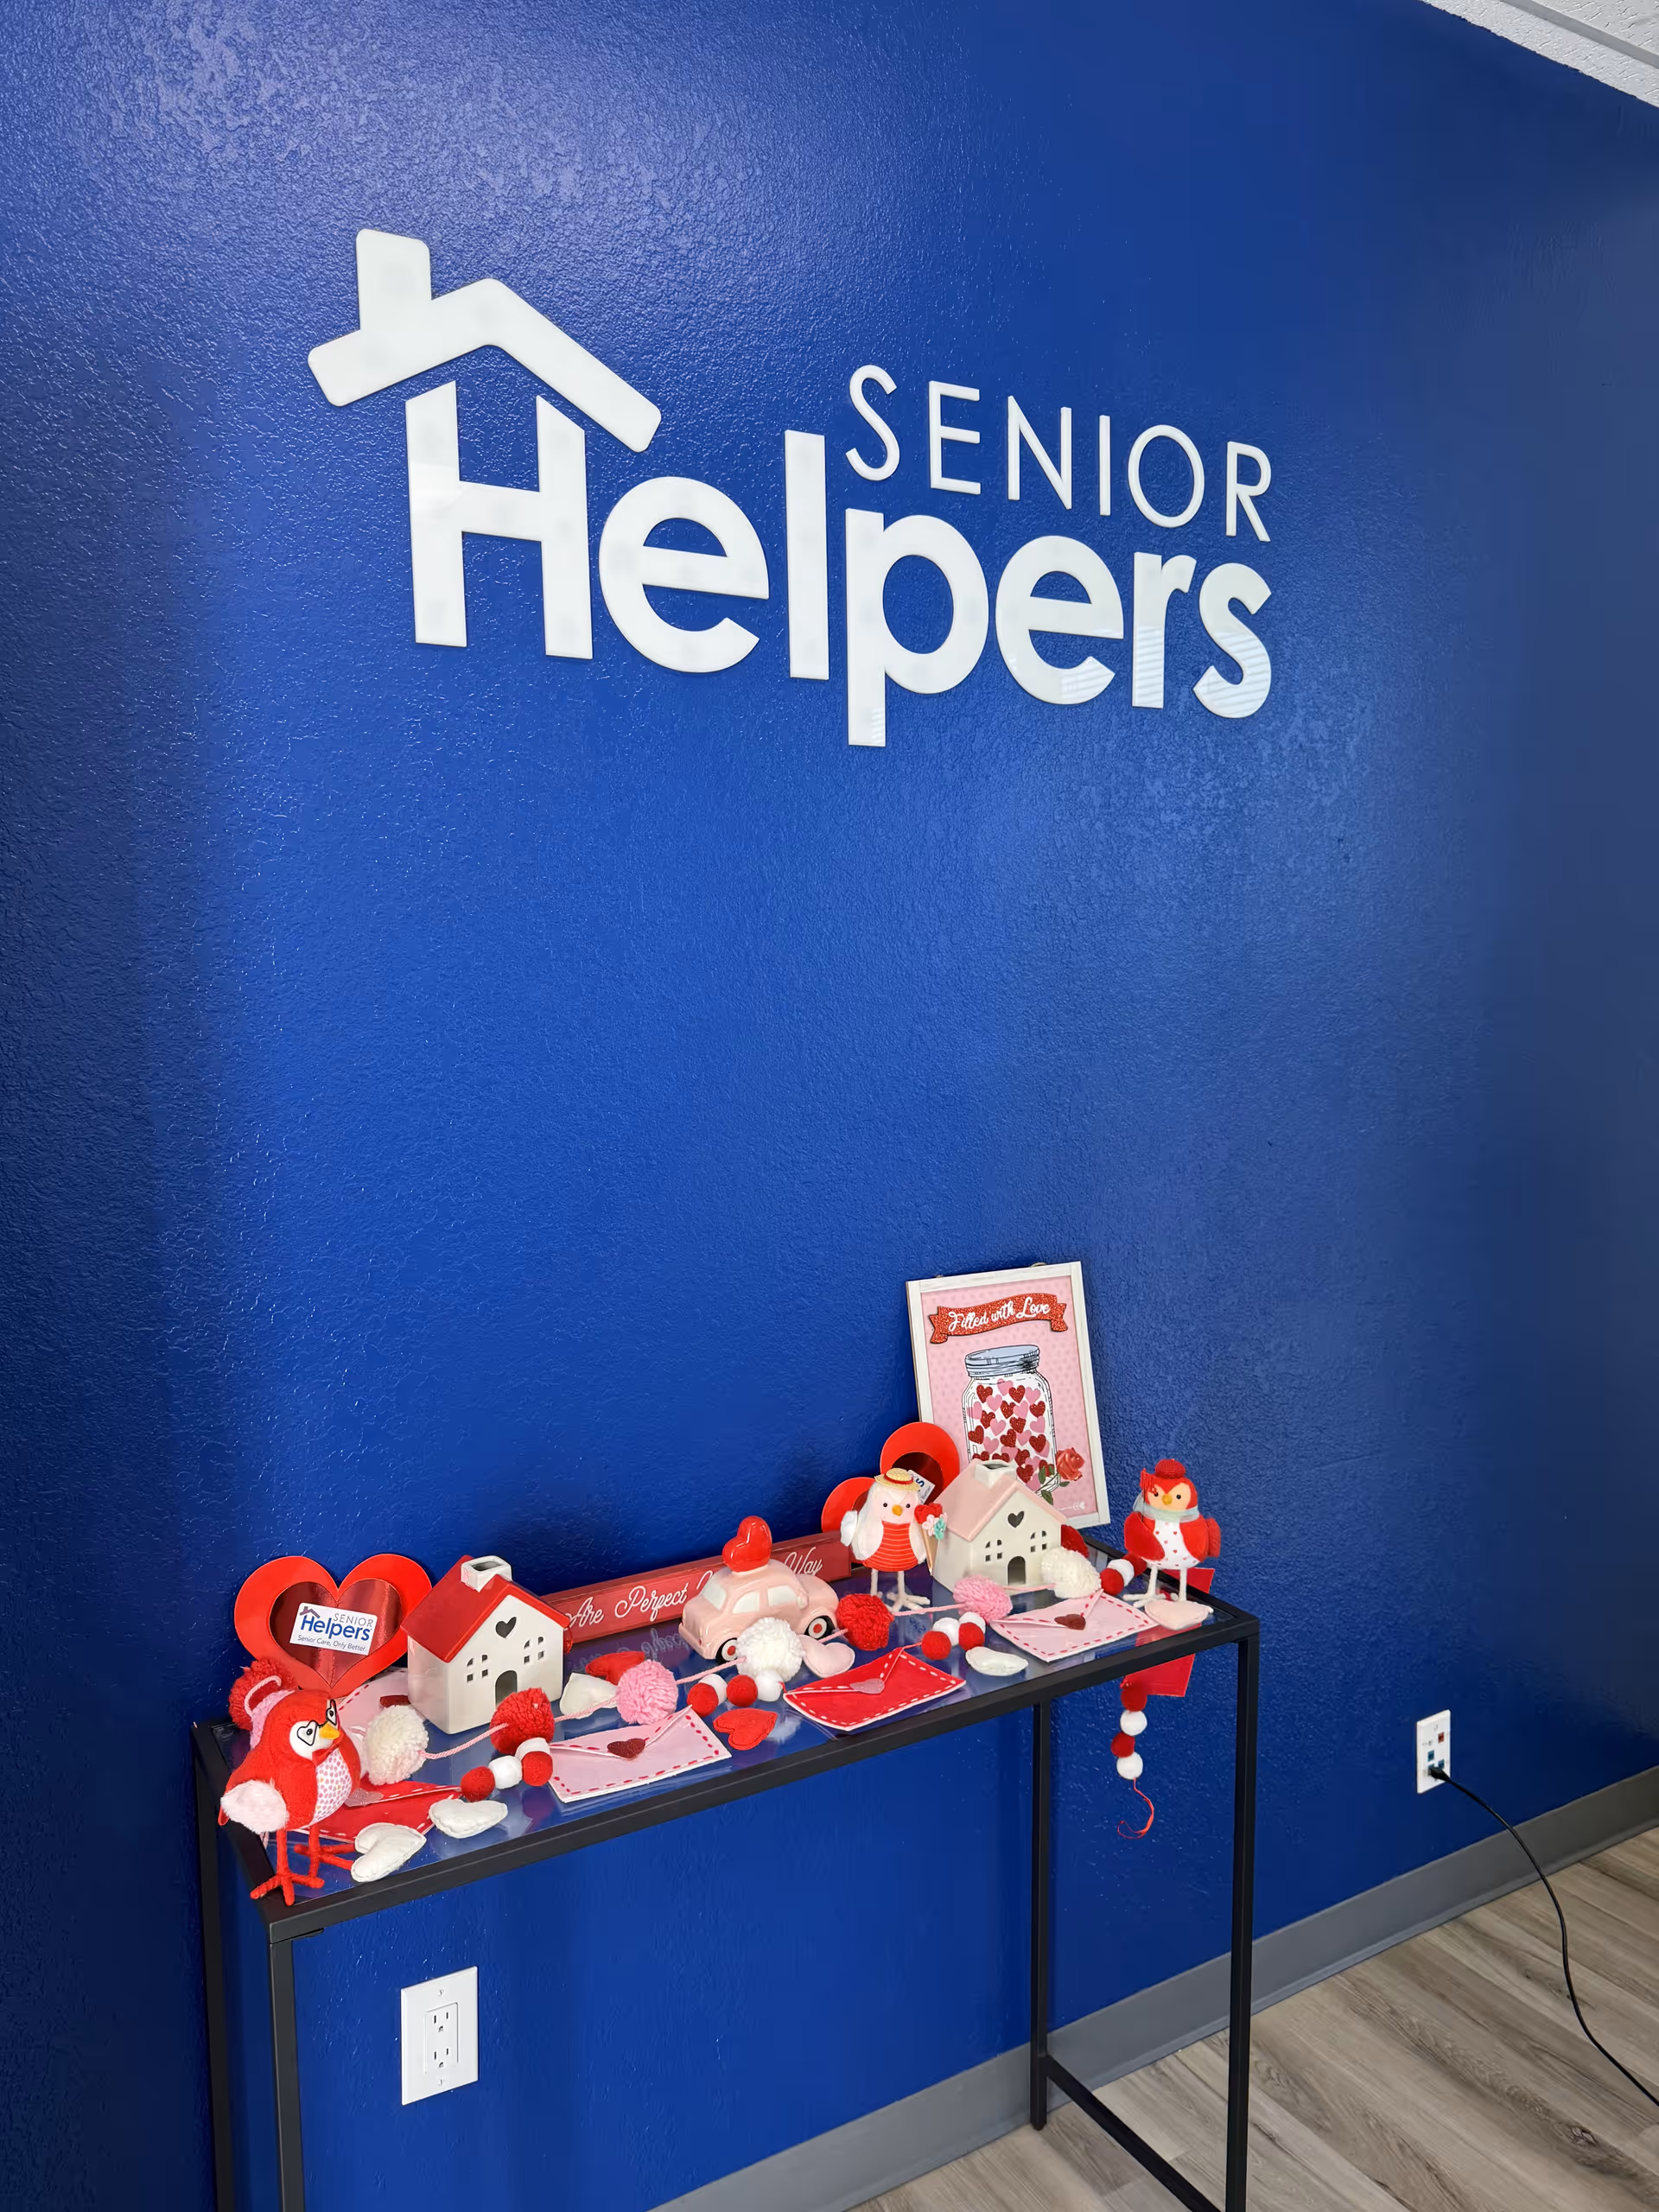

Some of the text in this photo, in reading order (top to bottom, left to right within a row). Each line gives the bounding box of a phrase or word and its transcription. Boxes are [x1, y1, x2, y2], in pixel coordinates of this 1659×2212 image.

[846, 365, 1272, 542] SENIOR
[405, 380, 1273, 747] Helpers
[948, 1296, 1051, 1332] Filled with Love
[565, 1547, 823, 1628] Are Perfect Way
[300, 1615, 371, 1642] Helpers
[333, 1613, 373, 1627] SENIOR
[316, 1638, 332, 1647] Care,
[333, 1640, 346, 1649] Only
